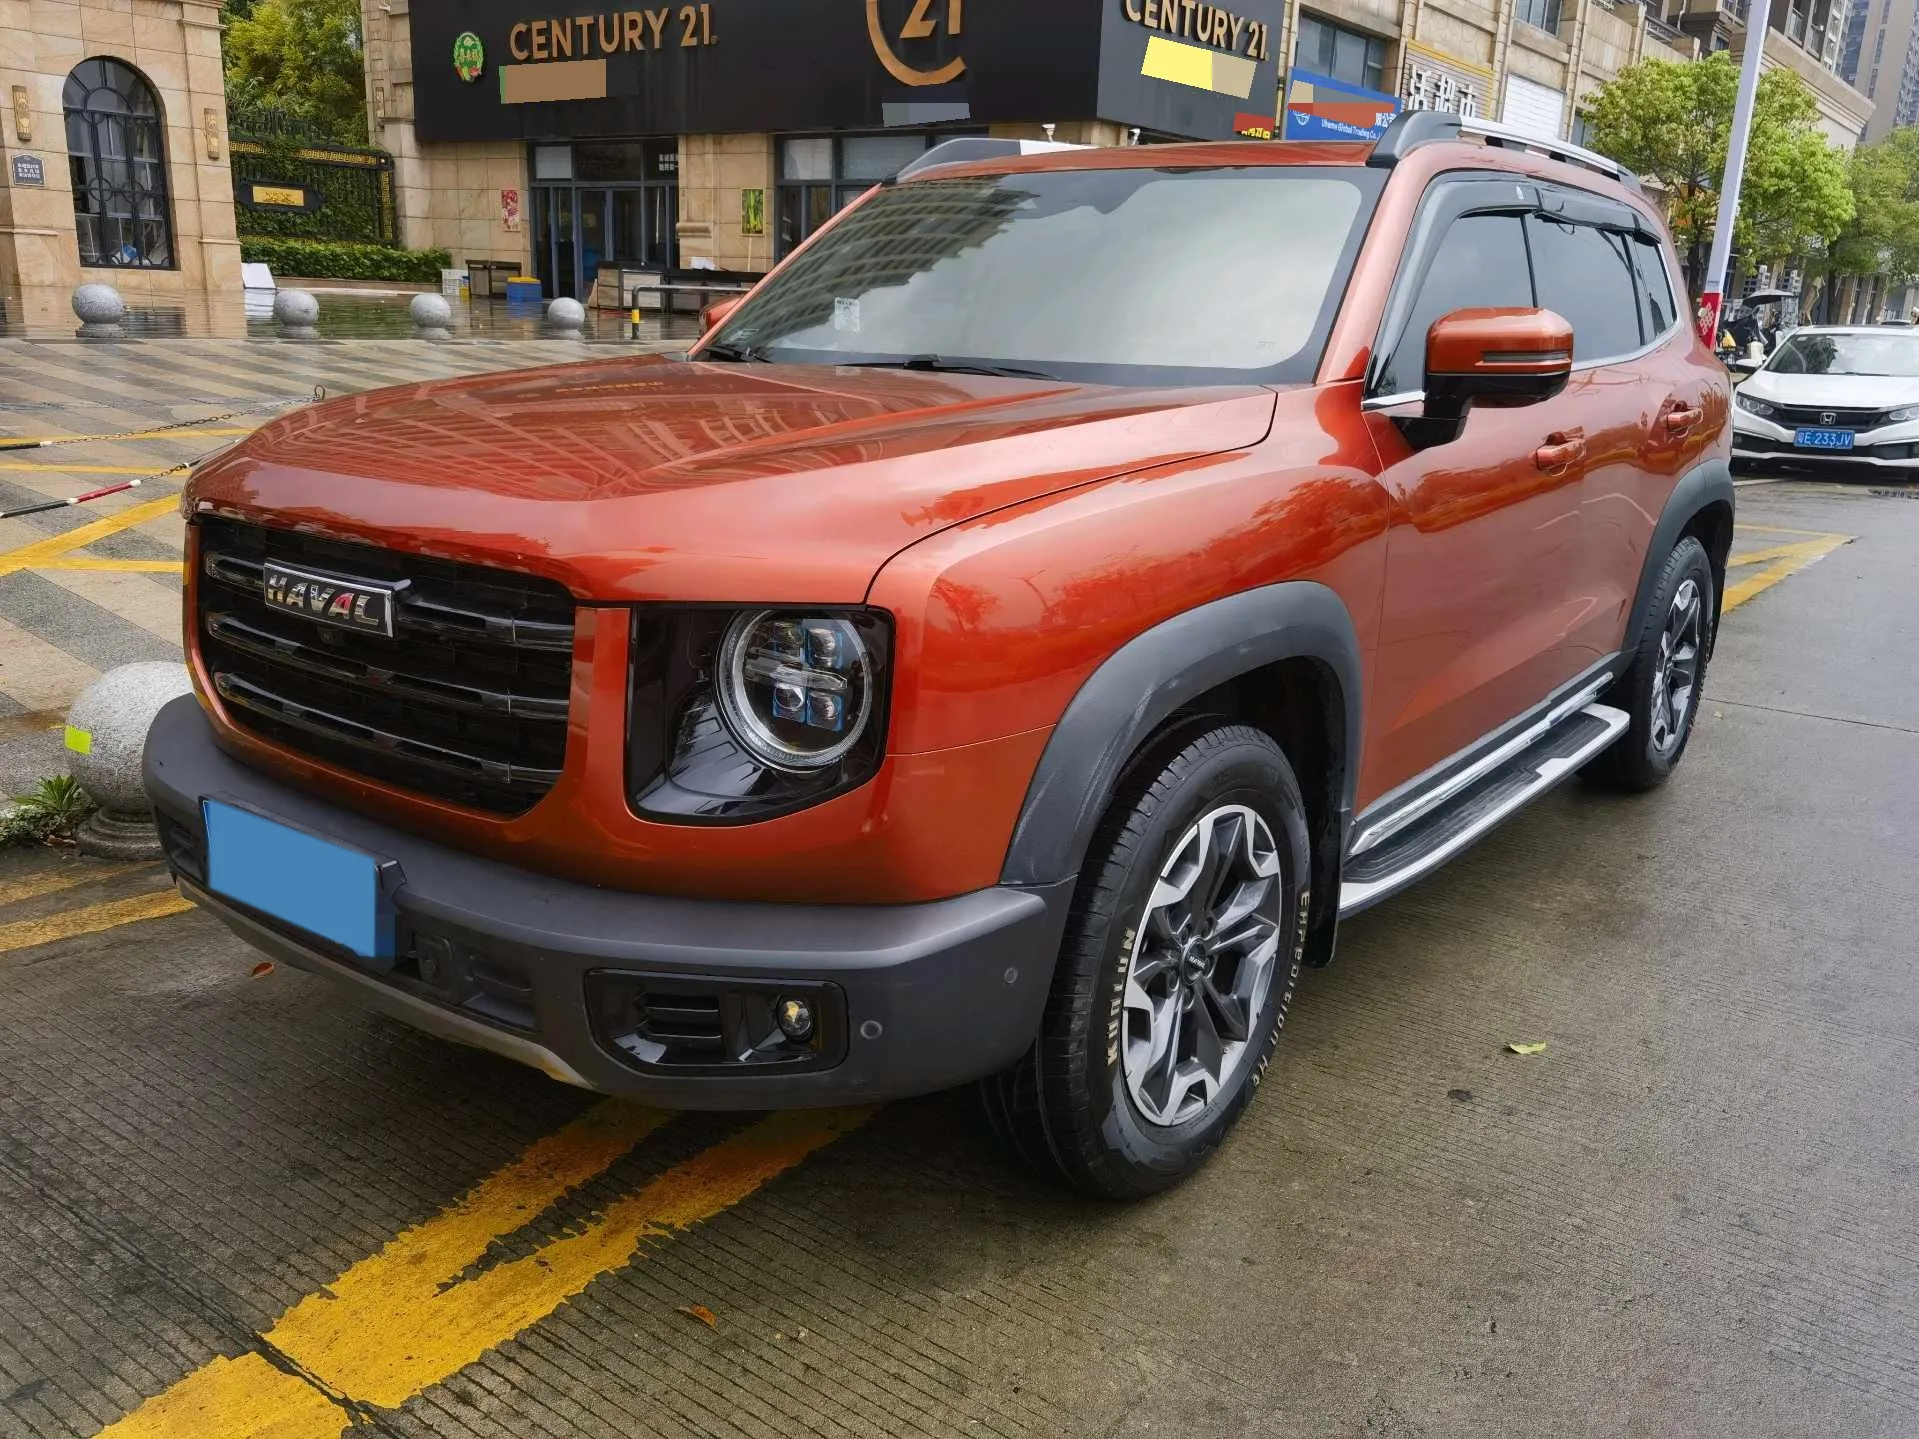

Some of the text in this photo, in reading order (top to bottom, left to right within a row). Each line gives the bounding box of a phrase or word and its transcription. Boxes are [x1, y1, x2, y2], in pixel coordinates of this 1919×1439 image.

[509, 7, 669, 60] CENTURY
[1126, 0, 1244, 50] CENTURY
[267, 574, 379, 626] HAVAL
